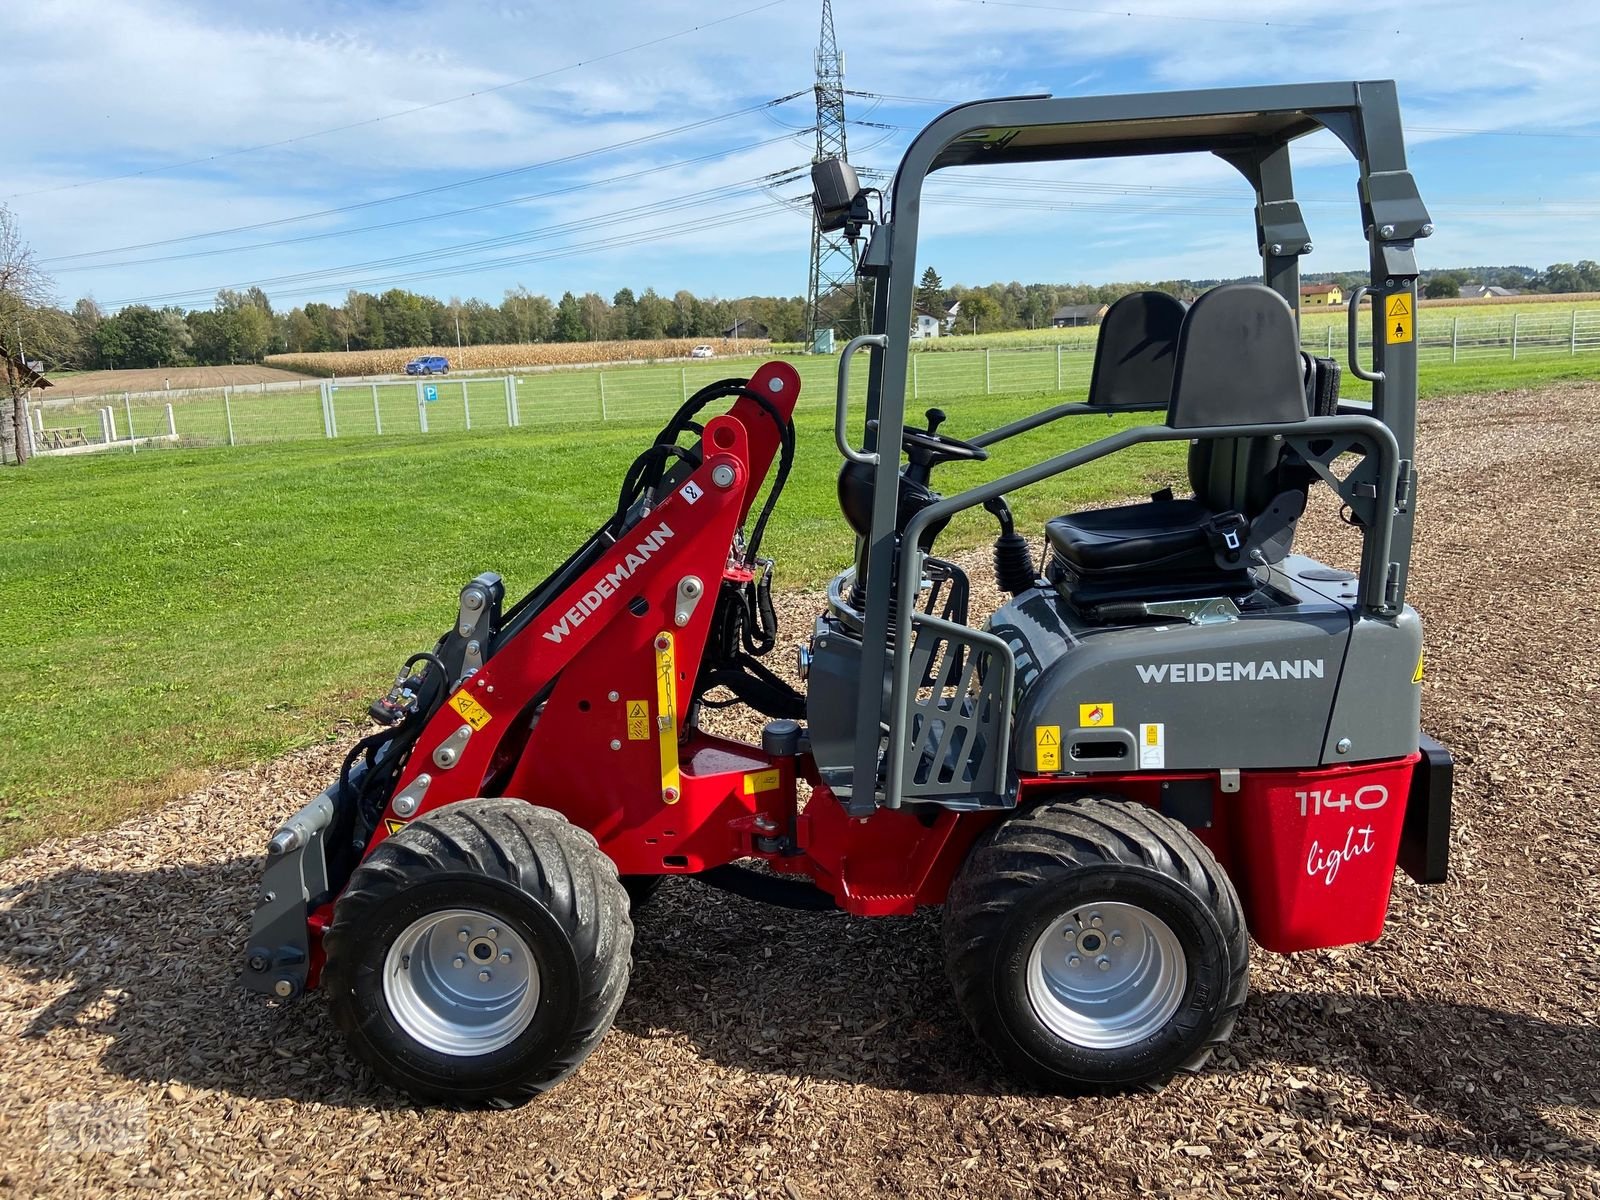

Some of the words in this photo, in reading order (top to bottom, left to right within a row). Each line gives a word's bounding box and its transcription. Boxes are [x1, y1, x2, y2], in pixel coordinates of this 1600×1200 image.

[426, 387, 435, 400] P
[542, 521, 675, 644] WEIDEMANN
[1135, 658, 1324, 684] WEIDEMANN
[1294, 784, 1389, 817] 1140
[1306, 823, 1376, 886] light
